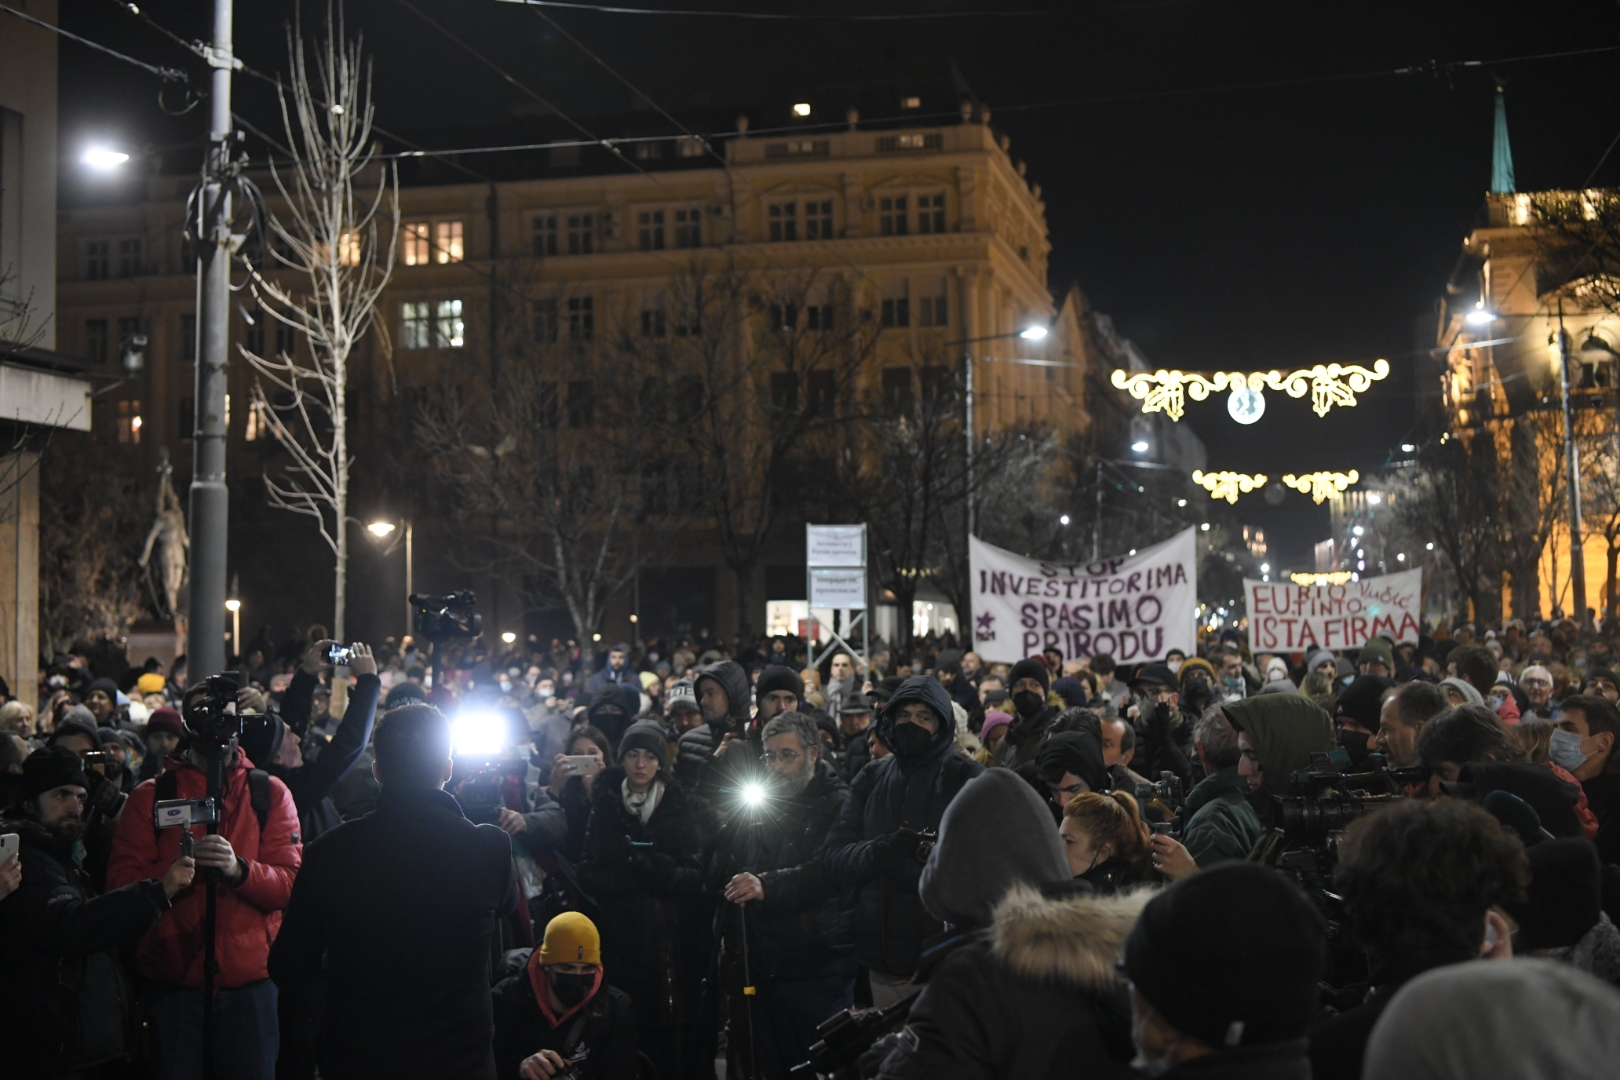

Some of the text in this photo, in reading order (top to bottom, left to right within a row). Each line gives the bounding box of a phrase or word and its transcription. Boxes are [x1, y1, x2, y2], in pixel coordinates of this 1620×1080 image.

[979, 563, 1188, 599] INVESTITORIMA
[1039, 557, 1124, 578] STOP
[1020, 594, 1163, 630] SPASIMO
[1254, 612, 1420, 648] ISTA FIRMA
[1022, 626, 1164, 661] PRIRODU
